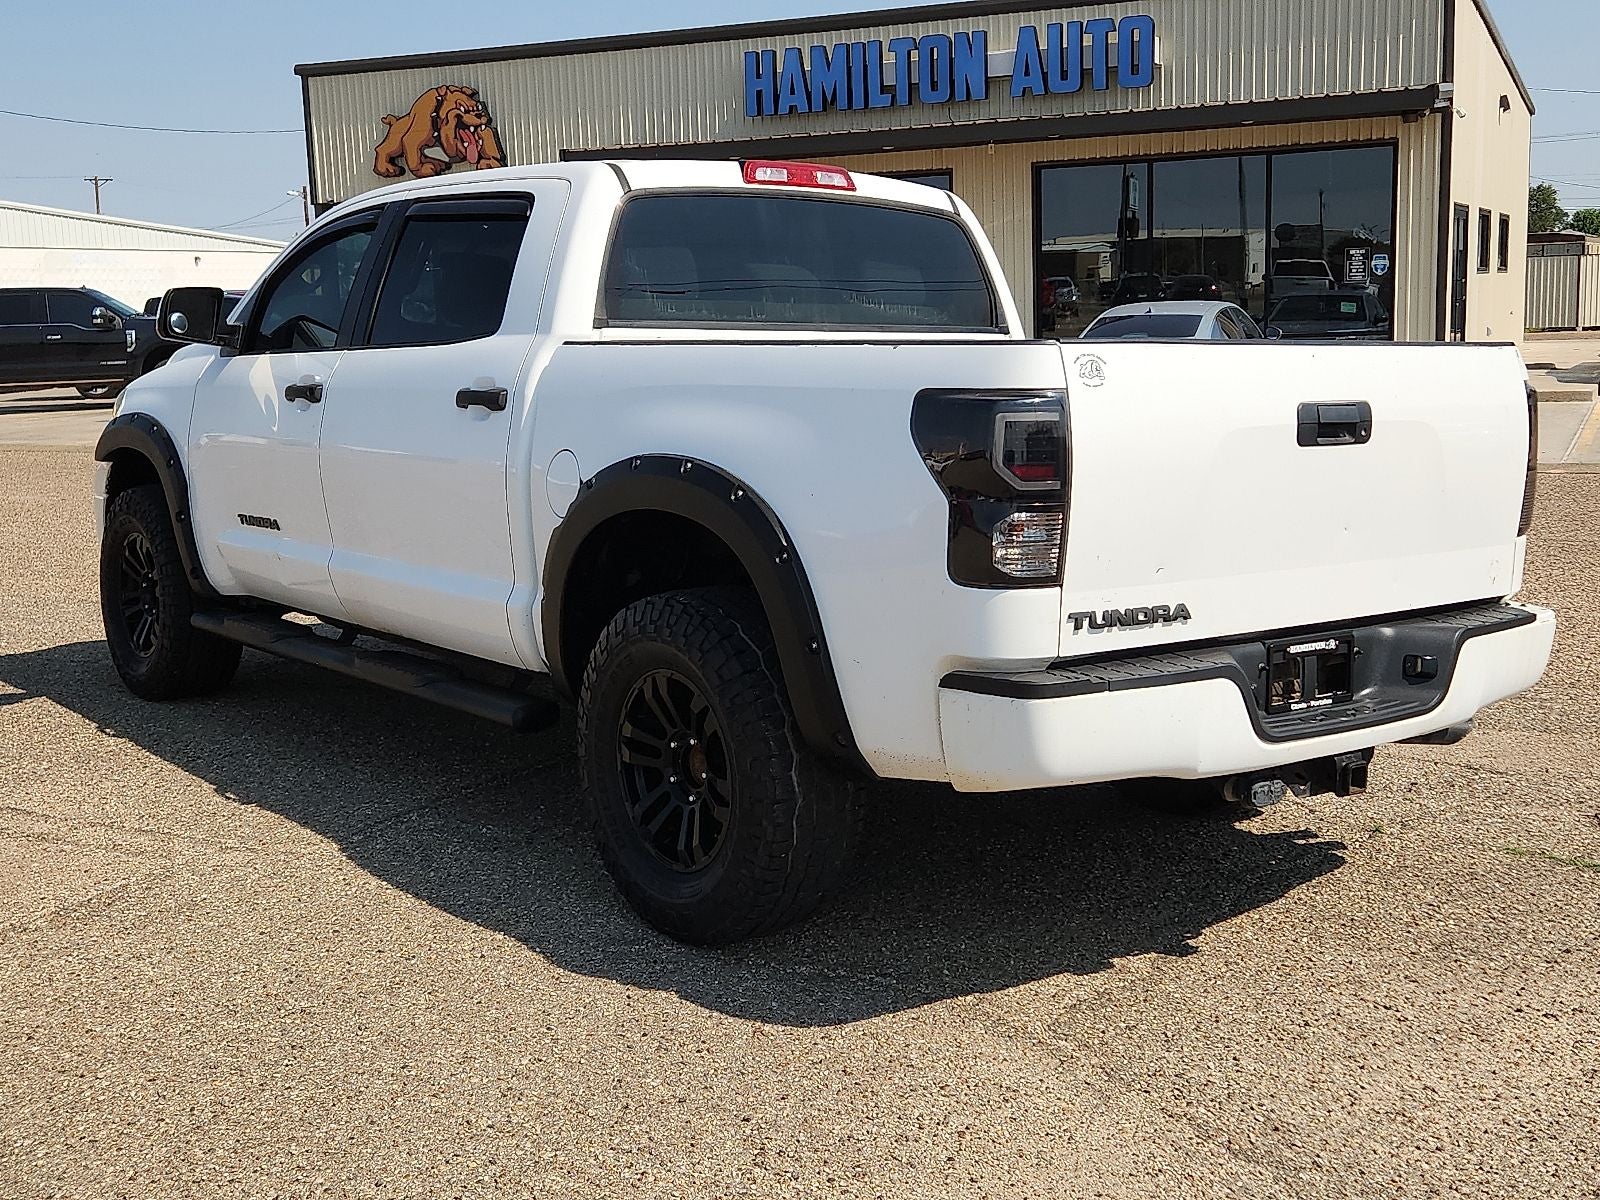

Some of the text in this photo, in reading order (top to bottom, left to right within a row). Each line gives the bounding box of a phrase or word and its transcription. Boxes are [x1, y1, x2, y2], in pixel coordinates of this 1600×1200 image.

[744, 15, 1156, 117] HAMILTON AUTO
[237, 513, 281, 531] TUNDRA
[1067, 603, 1192, 631] TUNDRA
